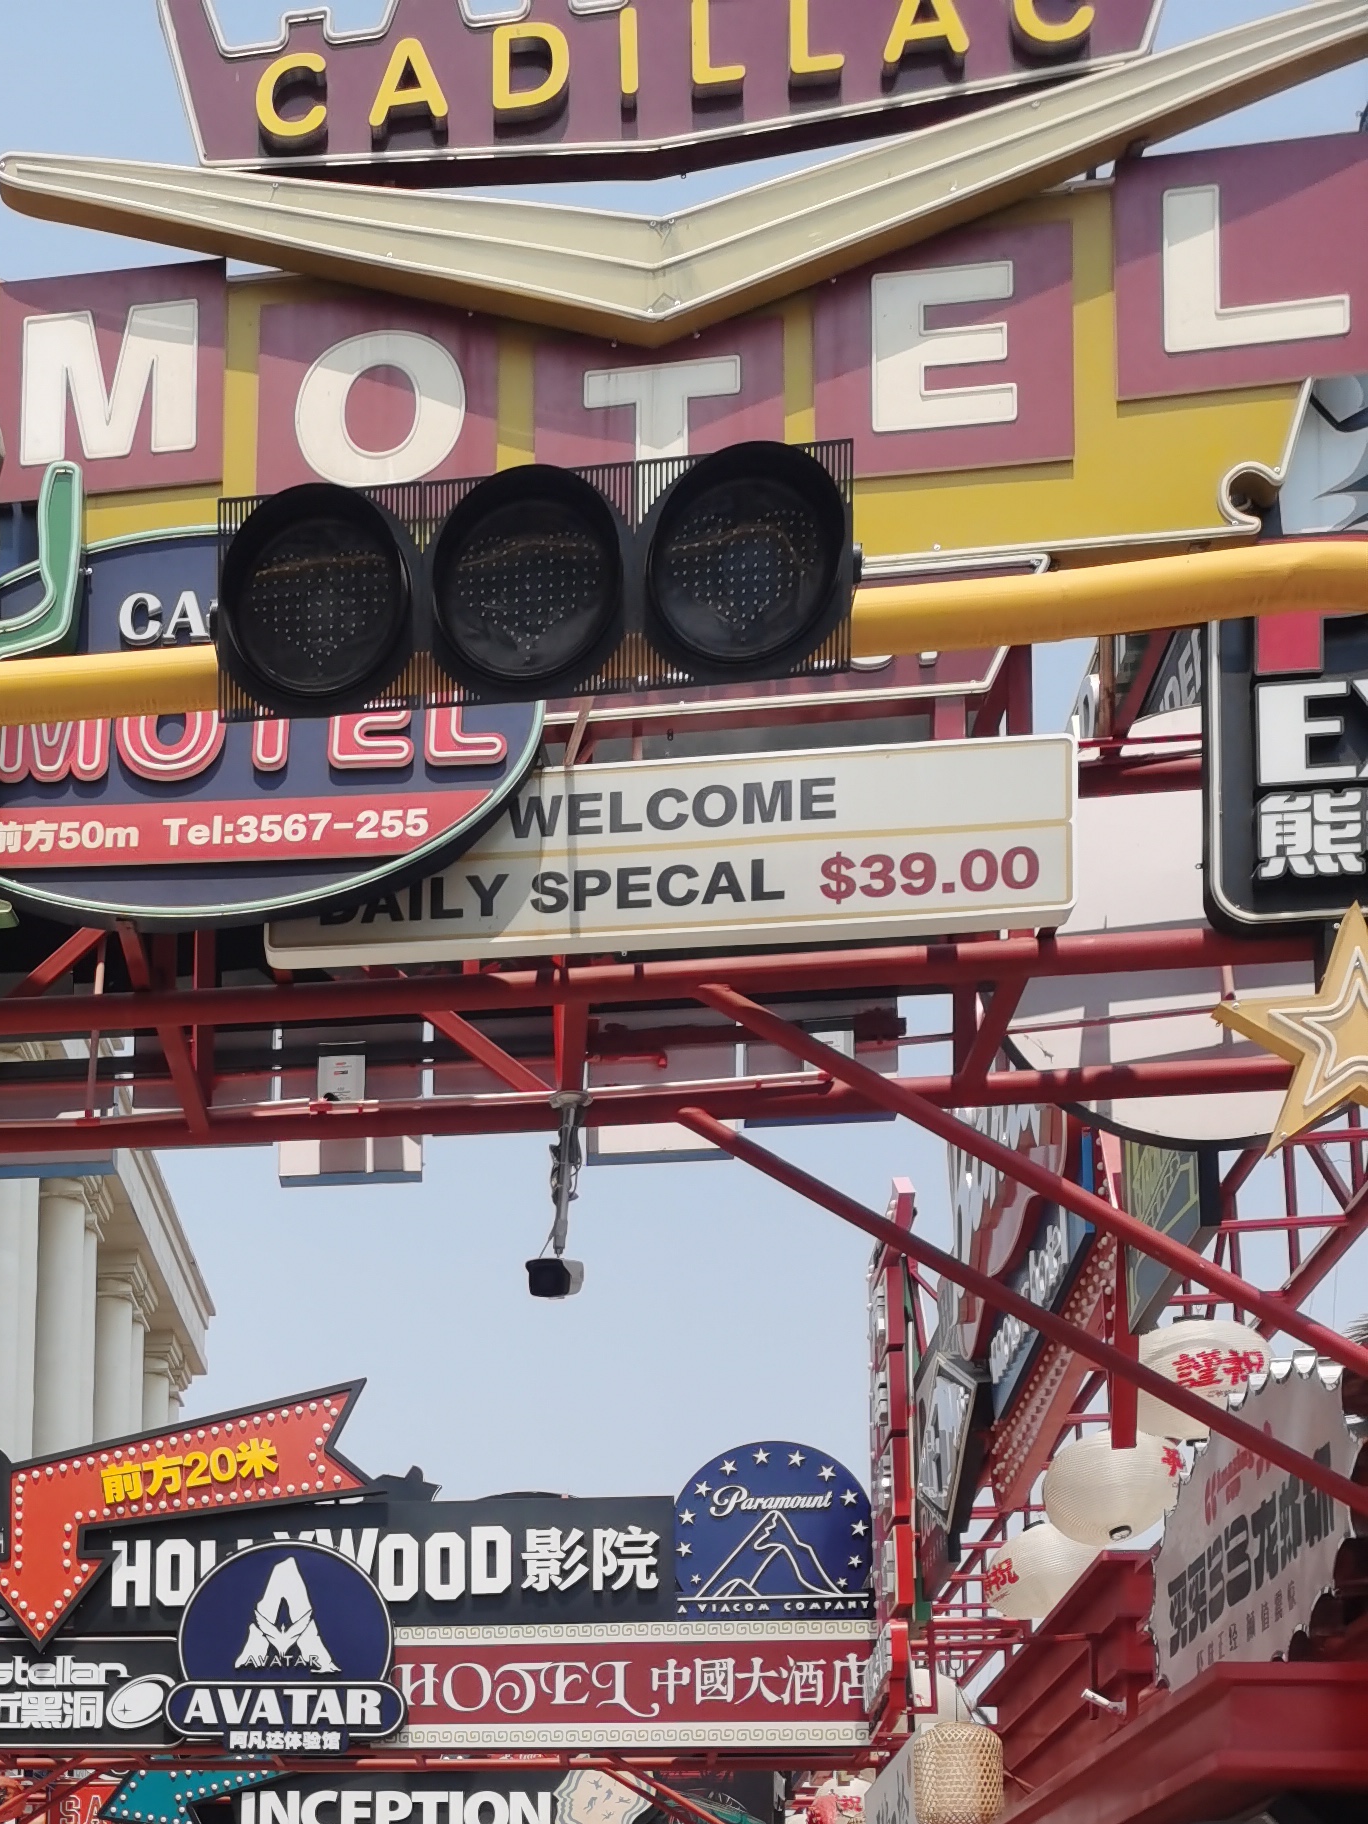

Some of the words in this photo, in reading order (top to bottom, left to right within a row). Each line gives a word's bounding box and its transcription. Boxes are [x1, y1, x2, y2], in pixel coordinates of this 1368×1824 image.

[255, 0, 1095, 138] CADILLAC
[20, 183, 1351, 488] MOTEL
[163, 807, 430, 847] Tel:3567-255
[510, 776, 837, 839] WELCOME
[531, 859, 785, 915] SPECAL
[820, 847, 1041, 904] $39.00
[101, 1438, 279, 1505] 前方20米
[709, 1485, 833, 1518] Paramount
[112, 1525, 512, 1608] HOWOOD
[521, 1525, 661, 1593] 影院
[677, 1603, 688, 1614] A
[698, 1601, 770, 1613] VIACOM
[784, 1599, 870, 1612] COMPANY
[244, 1653, 321, 1671] AVATAR
[390, 1660, 660, 1719] HOTEL
[650, 1654, 871, 1709] 中國大酒店
[183, 1688, 382, 1726] AVATAR
[229, 1731, 343, 1751] 阿凡达体验馆
